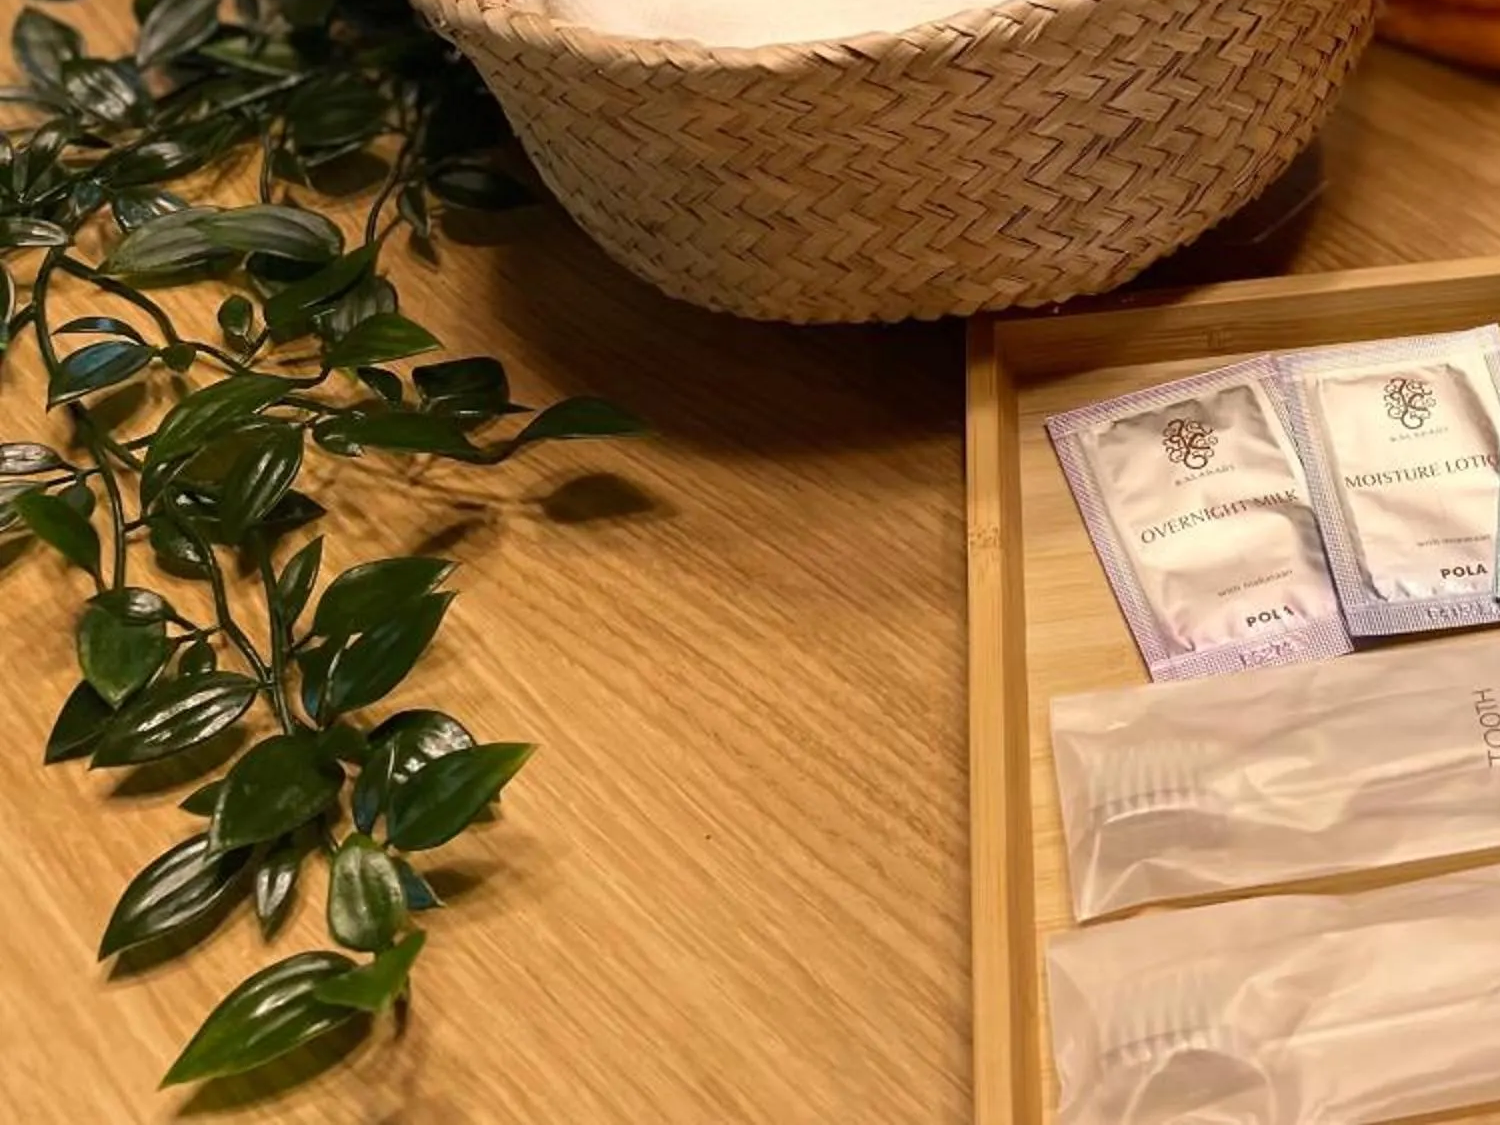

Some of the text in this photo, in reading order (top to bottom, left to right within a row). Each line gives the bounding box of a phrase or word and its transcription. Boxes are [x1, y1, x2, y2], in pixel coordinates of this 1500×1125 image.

[1344, 463, 1442, 490] MOISTURE
[1140, 488, 1299, 545] OVERNIGHT MILK
[1440, 563, 1489, 580] POLA
